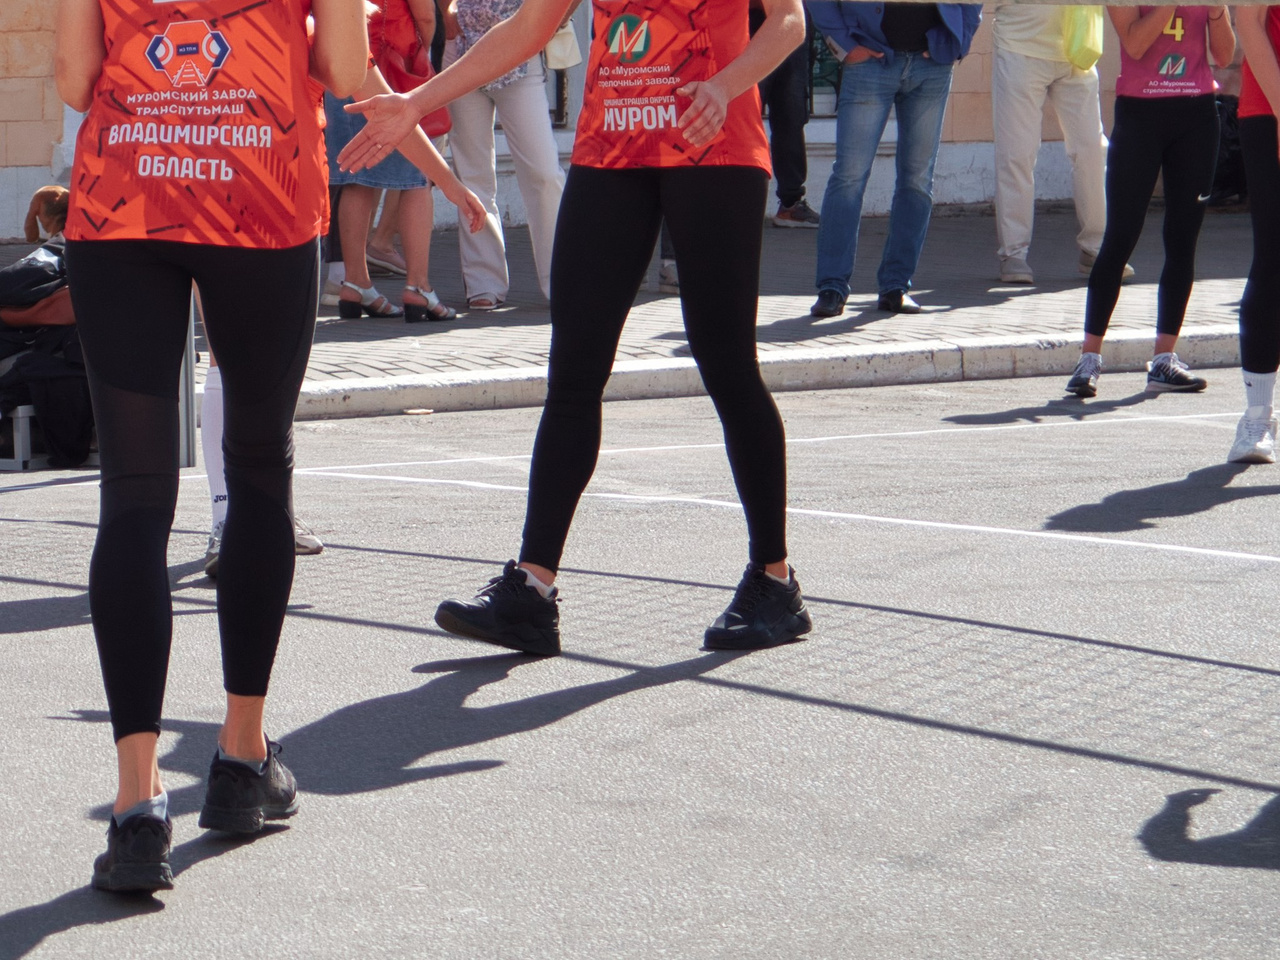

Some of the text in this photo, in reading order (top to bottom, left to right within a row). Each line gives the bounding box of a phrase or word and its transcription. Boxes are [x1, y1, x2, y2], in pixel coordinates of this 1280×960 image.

[1163, 7, 1185, 42] 4
[126, 88, 257, 104] МУРОМСКИЙ ЗАВОД
[135, 103, 245, 116] ТРАНСПУТЬМАШ
[603, 104, 677, 132] МУРОМ
[107, 121, 272, 148] ВЛАДИМИРСКАЯ
[138, 154, 234, 182] ОБЛАСТЬ
